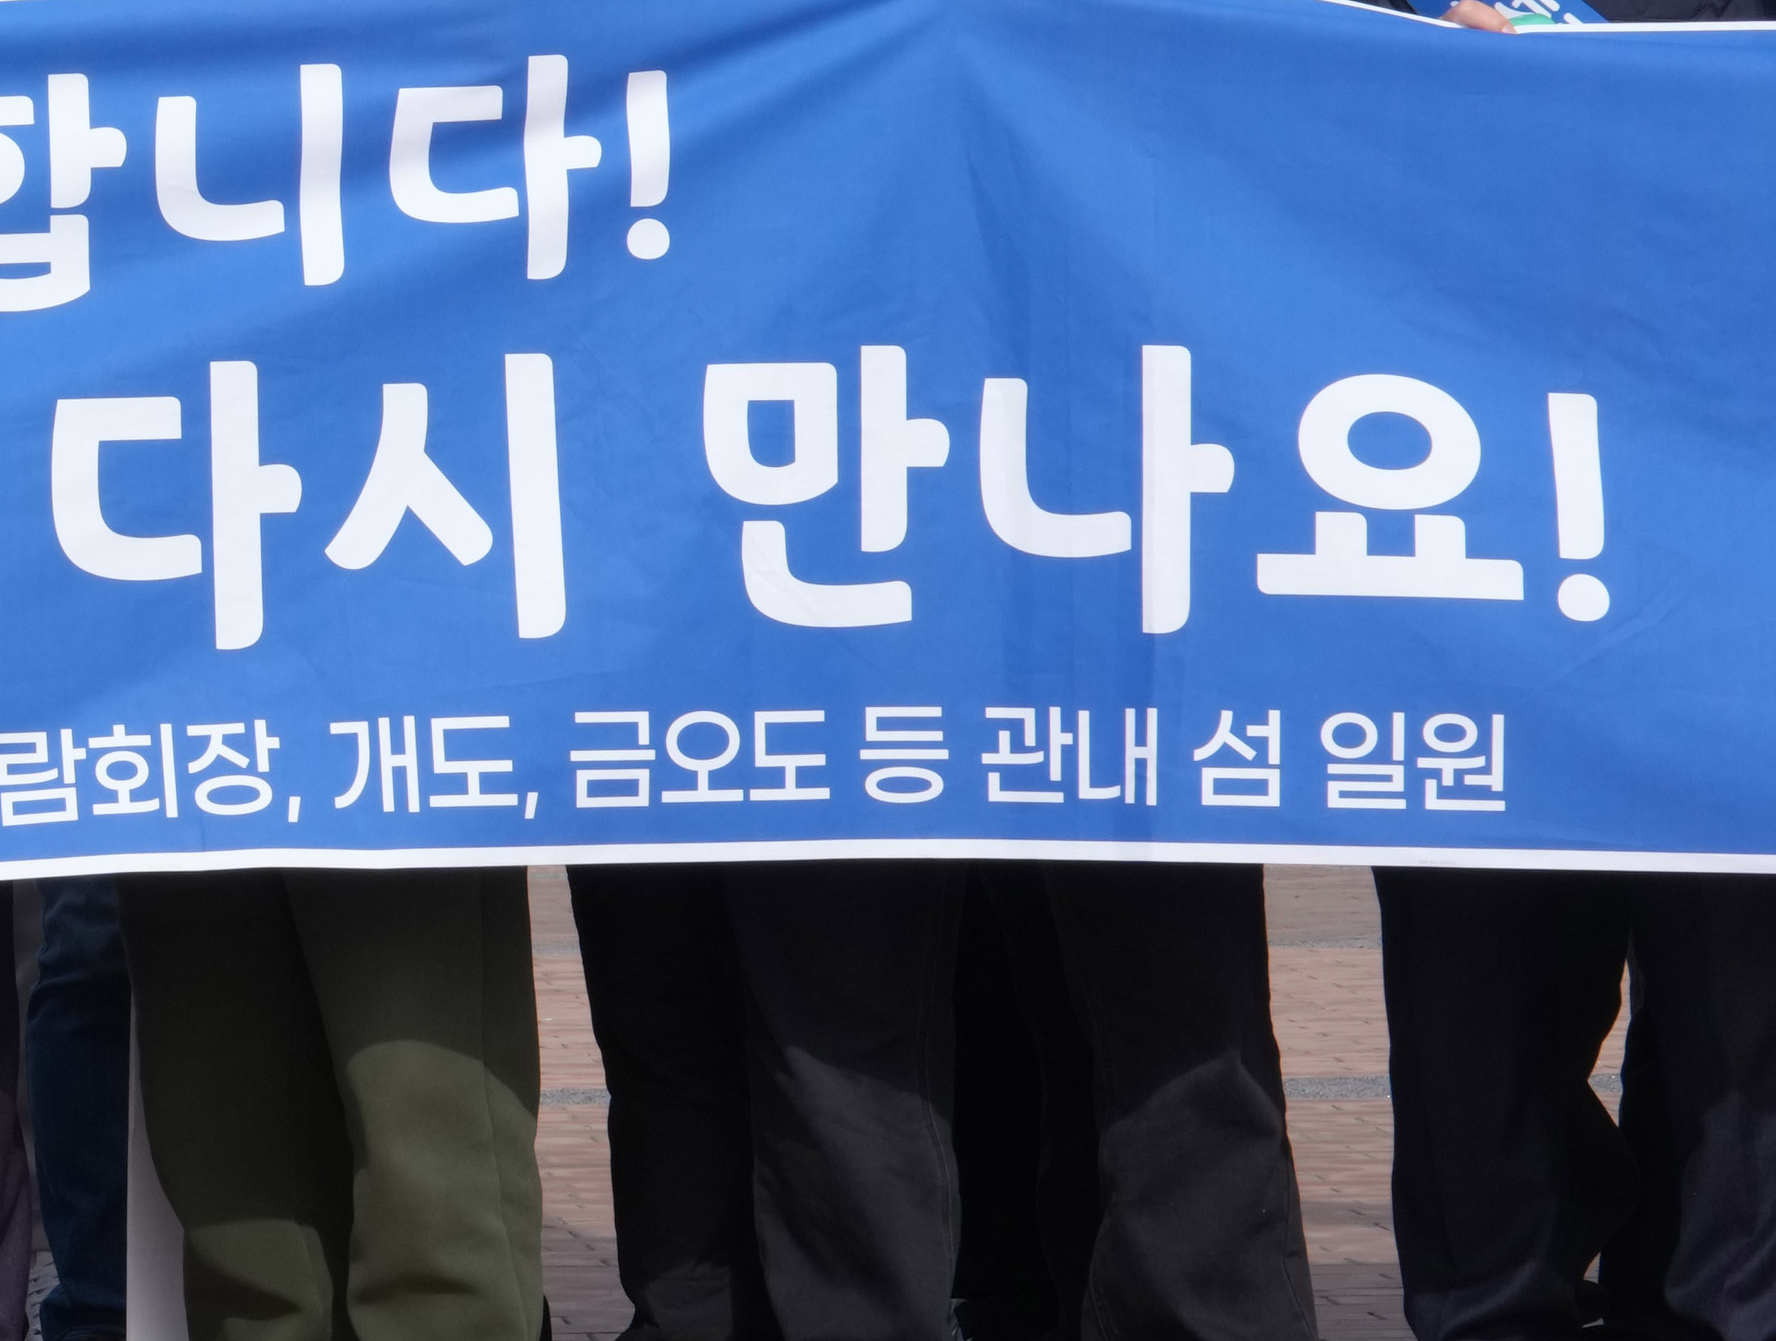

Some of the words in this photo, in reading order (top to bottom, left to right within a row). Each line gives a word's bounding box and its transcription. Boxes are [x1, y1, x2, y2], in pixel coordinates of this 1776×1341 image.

[51, 353, 566, 651] 다시
[703, 344, 1610, 635] 만나요!
[330, 714, 539, 820] 개도,
[569, 710, 831, 809] 금오도
[859, 706, 949, 804] 등
[981, 705, 1159, 806] 관내
[1193, 709, 1281, 808] 섬
[1320, 711, 1506, 812] 일원
